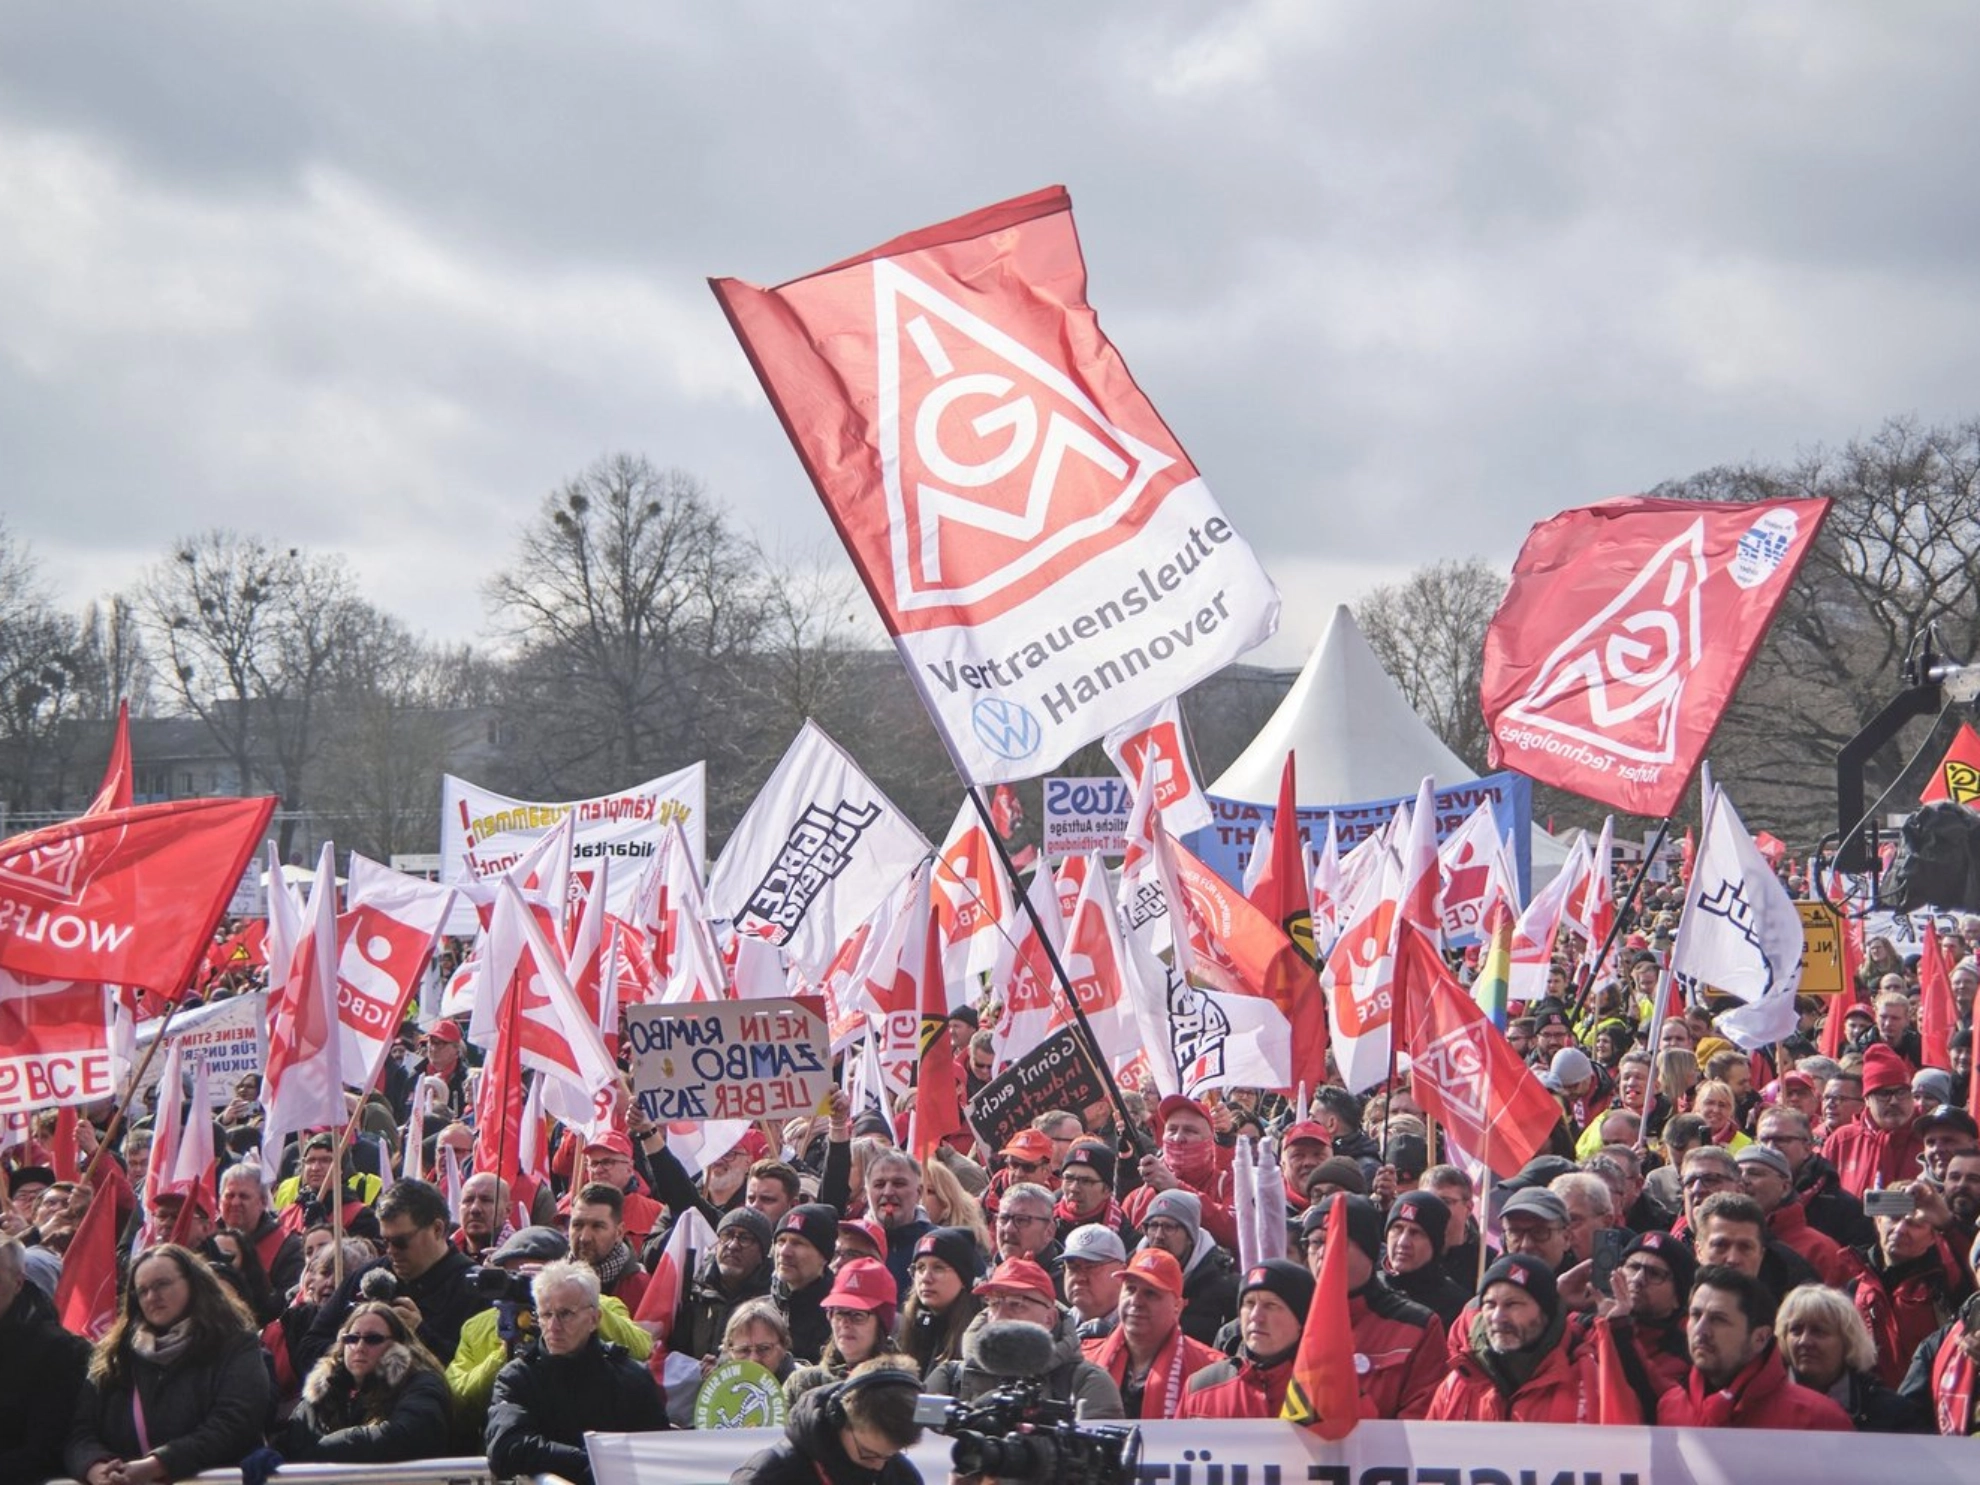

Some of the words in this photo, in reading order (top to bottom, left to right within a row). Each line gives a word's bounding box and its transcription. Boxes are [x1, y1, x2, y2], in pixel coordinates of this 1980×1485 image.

[927, 514, 1233, 692] Vertrauensleute
[1041, 589, 1231, 726] Hannover
[971, 696, 1042, 760] VW
